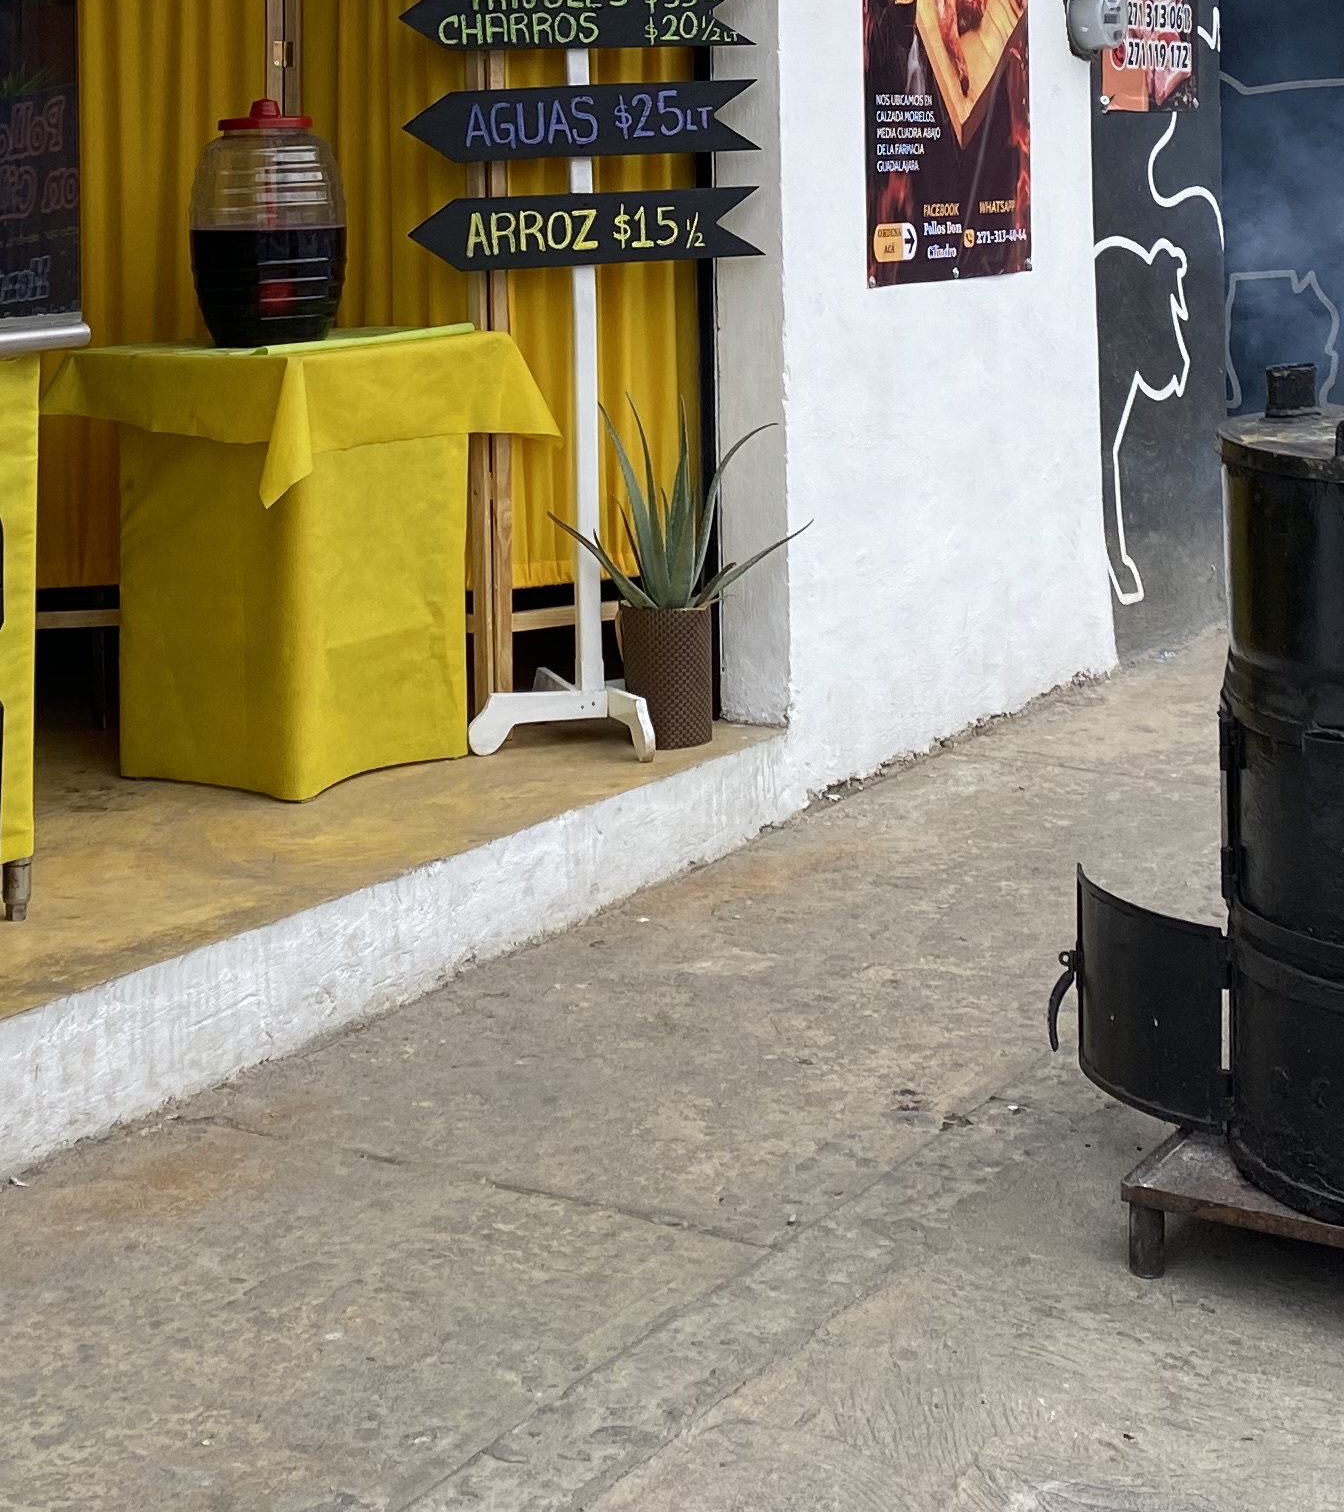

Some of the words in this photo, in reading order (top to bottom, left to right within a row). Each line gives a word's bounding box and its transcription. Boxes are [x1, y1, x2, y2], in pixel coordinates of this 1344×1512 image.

[438, 10, 600, 45] CHARROS
[1127, 0, 1143, 27] 271
[1145, 1, 1167, 29] 313
[1128, 40, 1146, 67] 271
[464, 96, 599, 149] AGUAS
[466, 208, 599, 258] ARROZ
